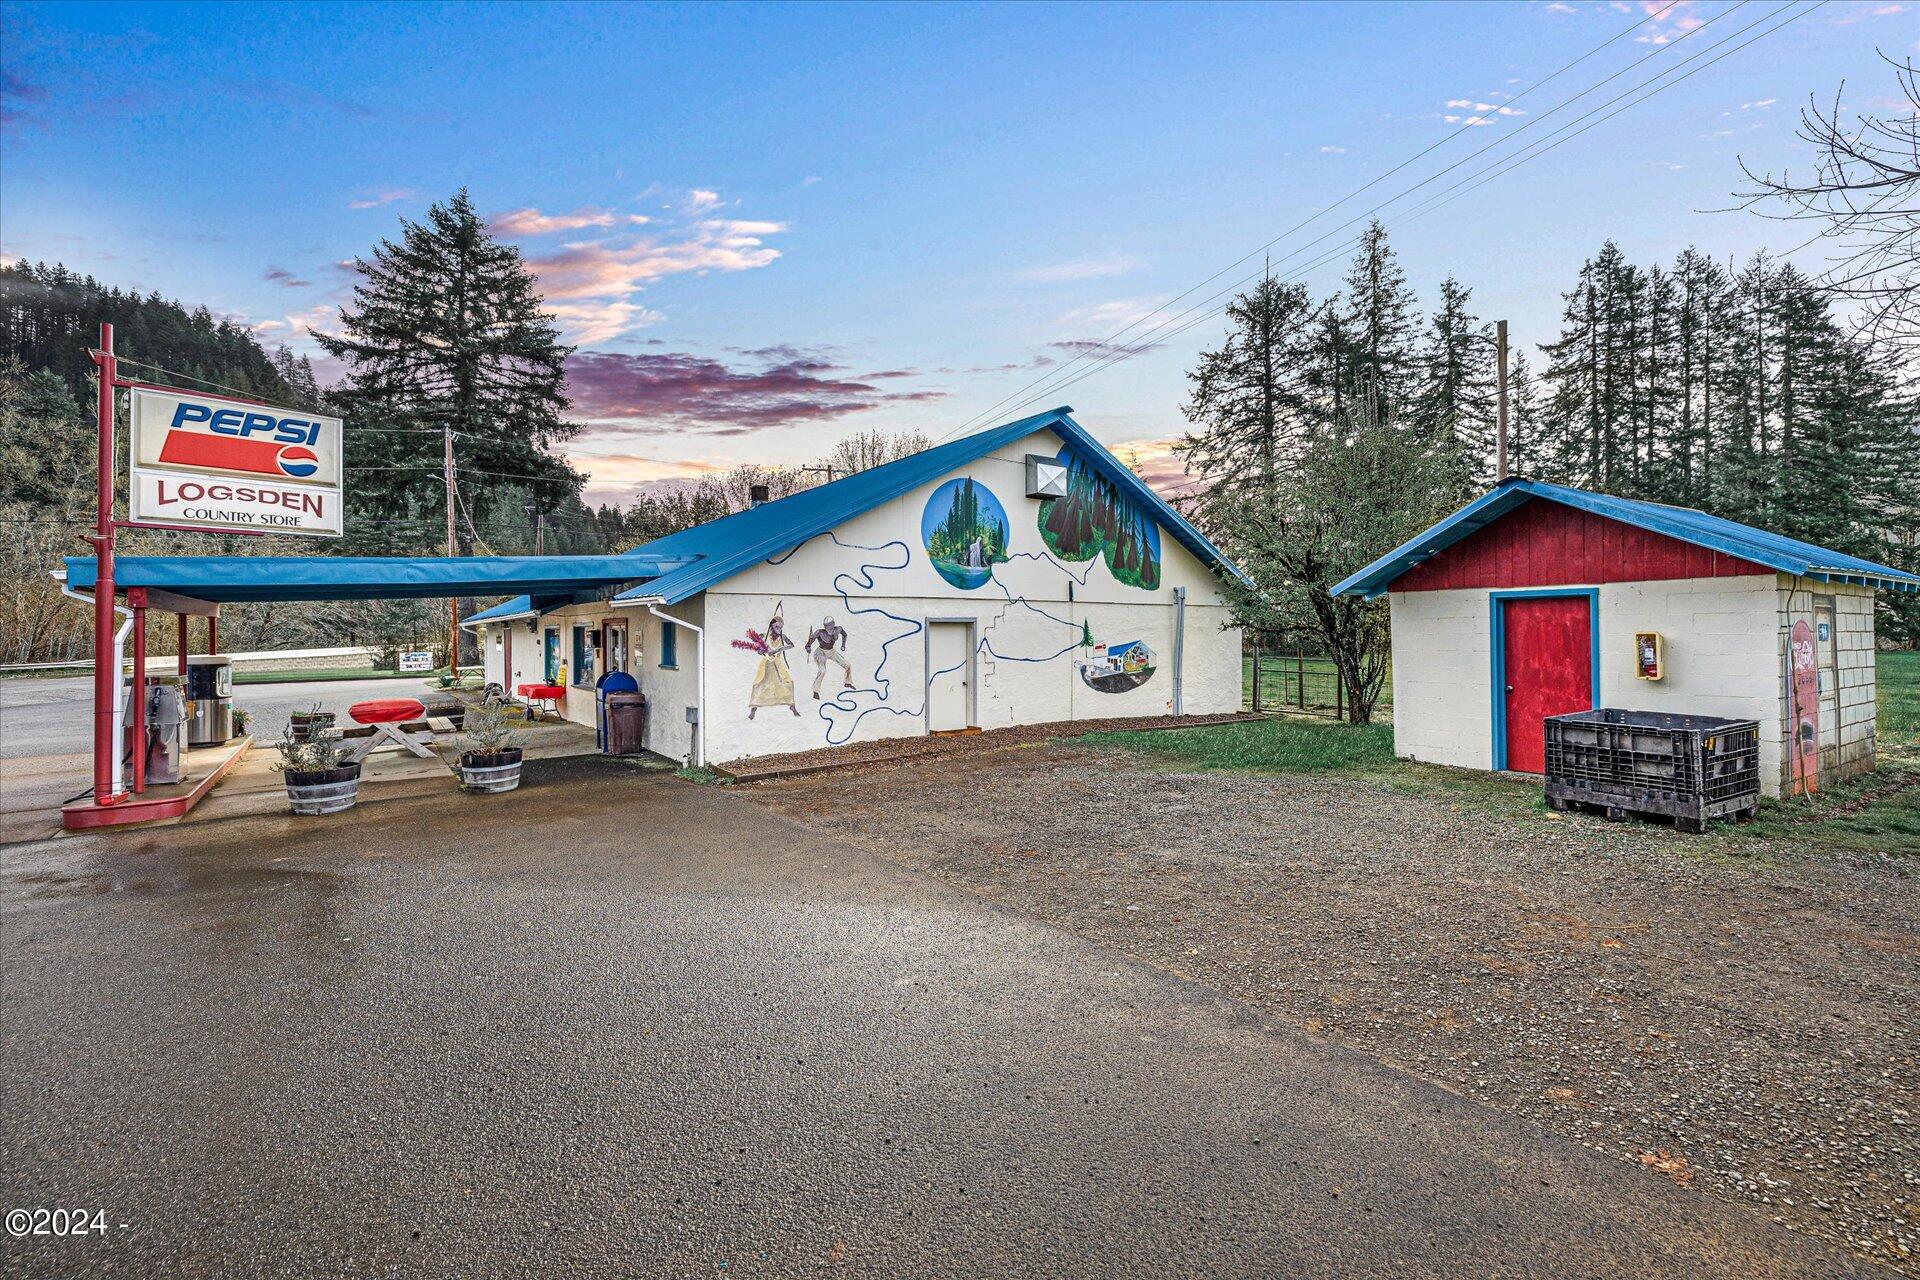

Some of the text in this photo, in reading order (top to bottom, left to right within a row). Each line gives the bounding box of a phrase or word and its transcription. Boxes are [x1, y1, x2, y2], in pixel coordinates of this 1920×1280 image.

[171, 403, 321, 445] PEPSI
[158, 480, 323, 519] LOGSDEN
[183, 508, 301, 526] COUNTRY STORE
